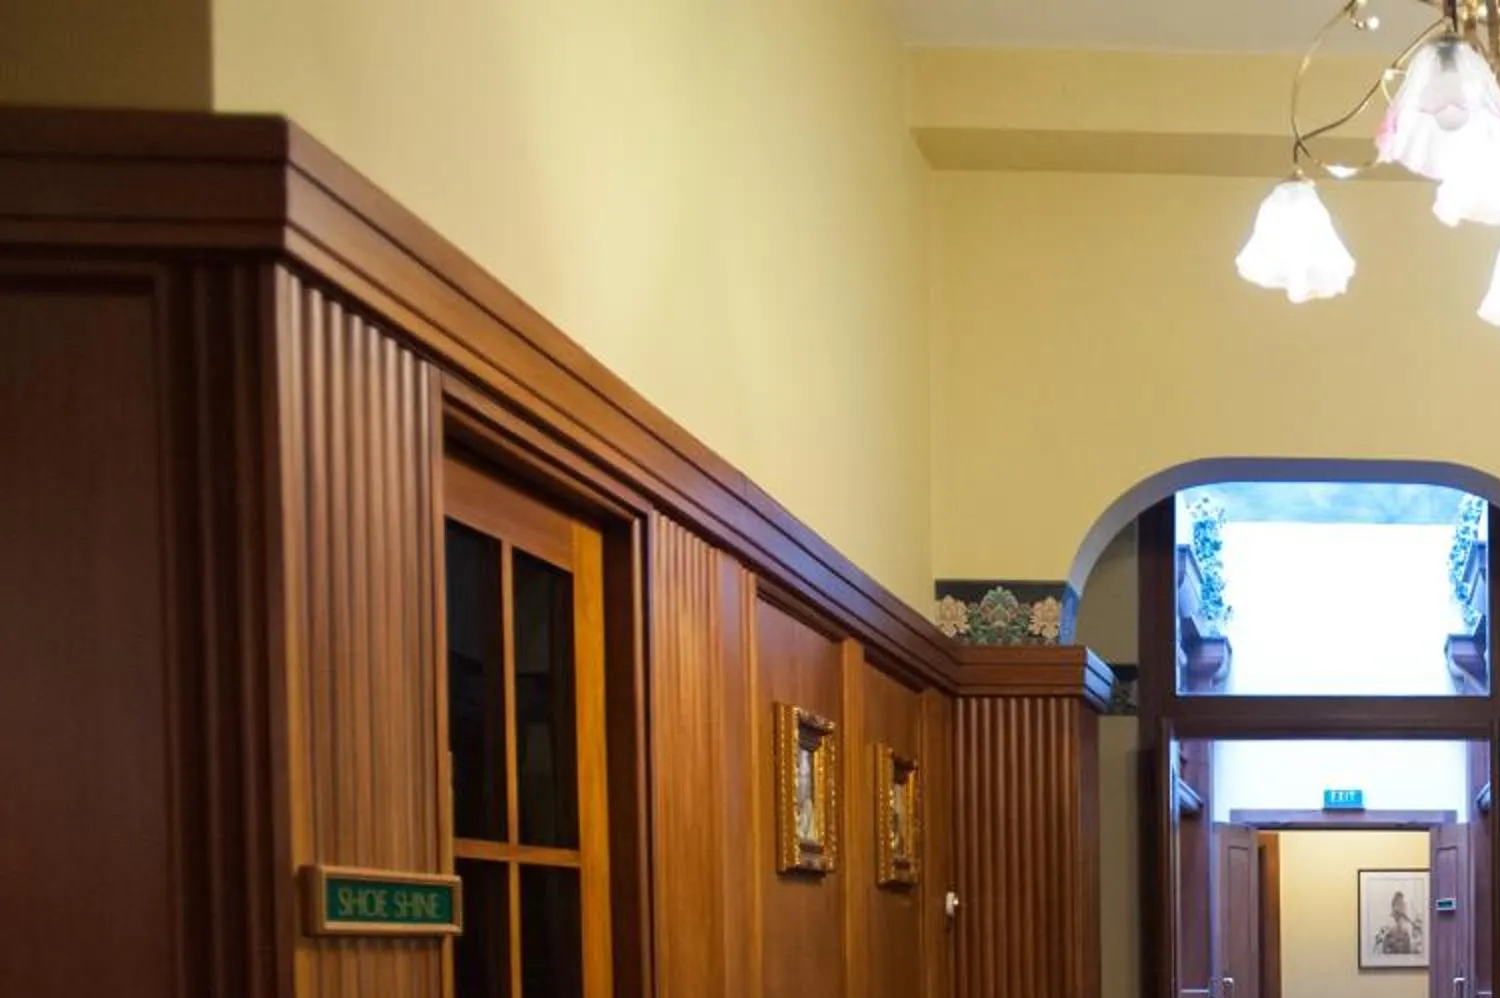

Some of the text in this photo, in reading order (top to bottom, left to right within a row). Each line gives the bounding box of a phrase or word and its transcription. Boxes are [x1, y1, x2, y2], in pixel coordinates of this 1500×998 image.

[1331, 790, 1355, 802] EXIT
[338, 887, 443, 918] SHOE SHINE
